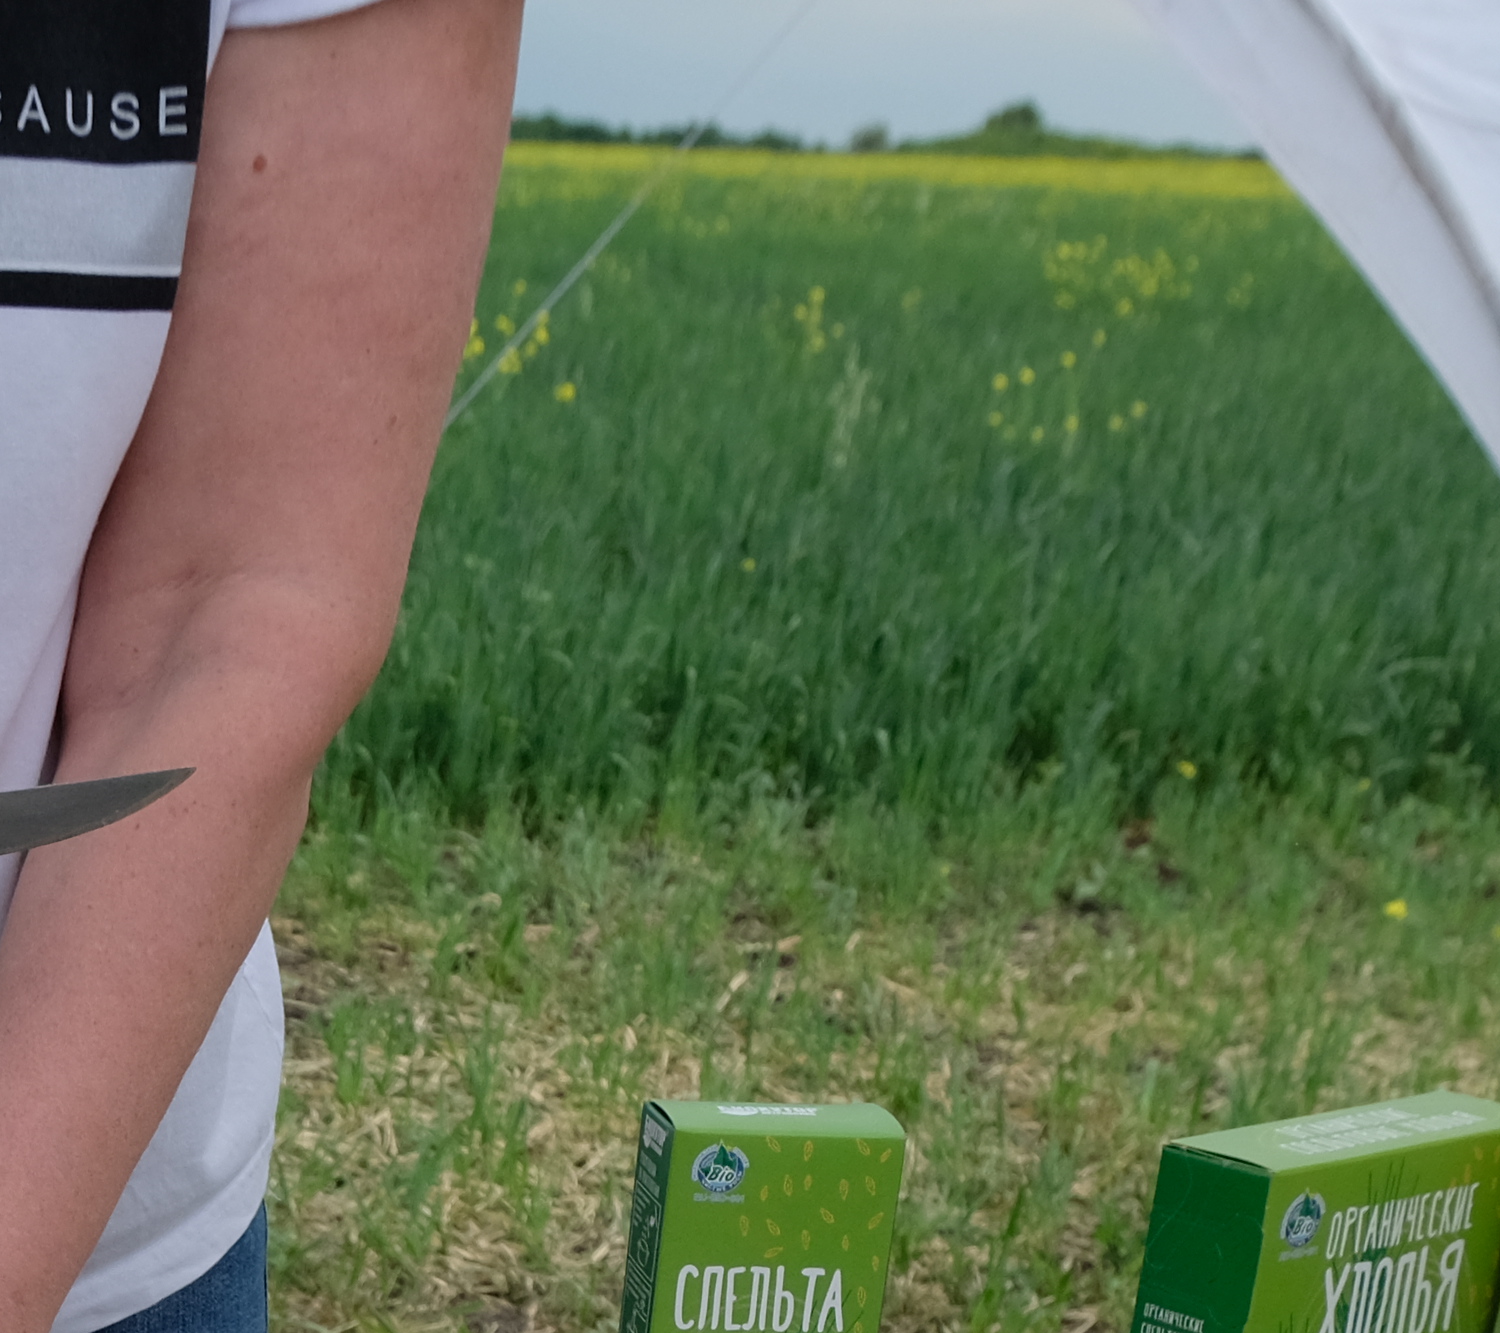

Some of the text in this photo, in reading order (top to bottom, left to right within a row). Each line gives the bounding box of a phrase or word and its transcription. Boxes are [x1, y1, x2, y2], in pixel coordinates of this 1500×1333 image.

[707, 1165, 736, 1183] Bio
[1325, 1182, 1480, 1259] ОРГАНИЧЕСКИЕ
[673, 1264, 844, 1333] СПЕЛЬТА
